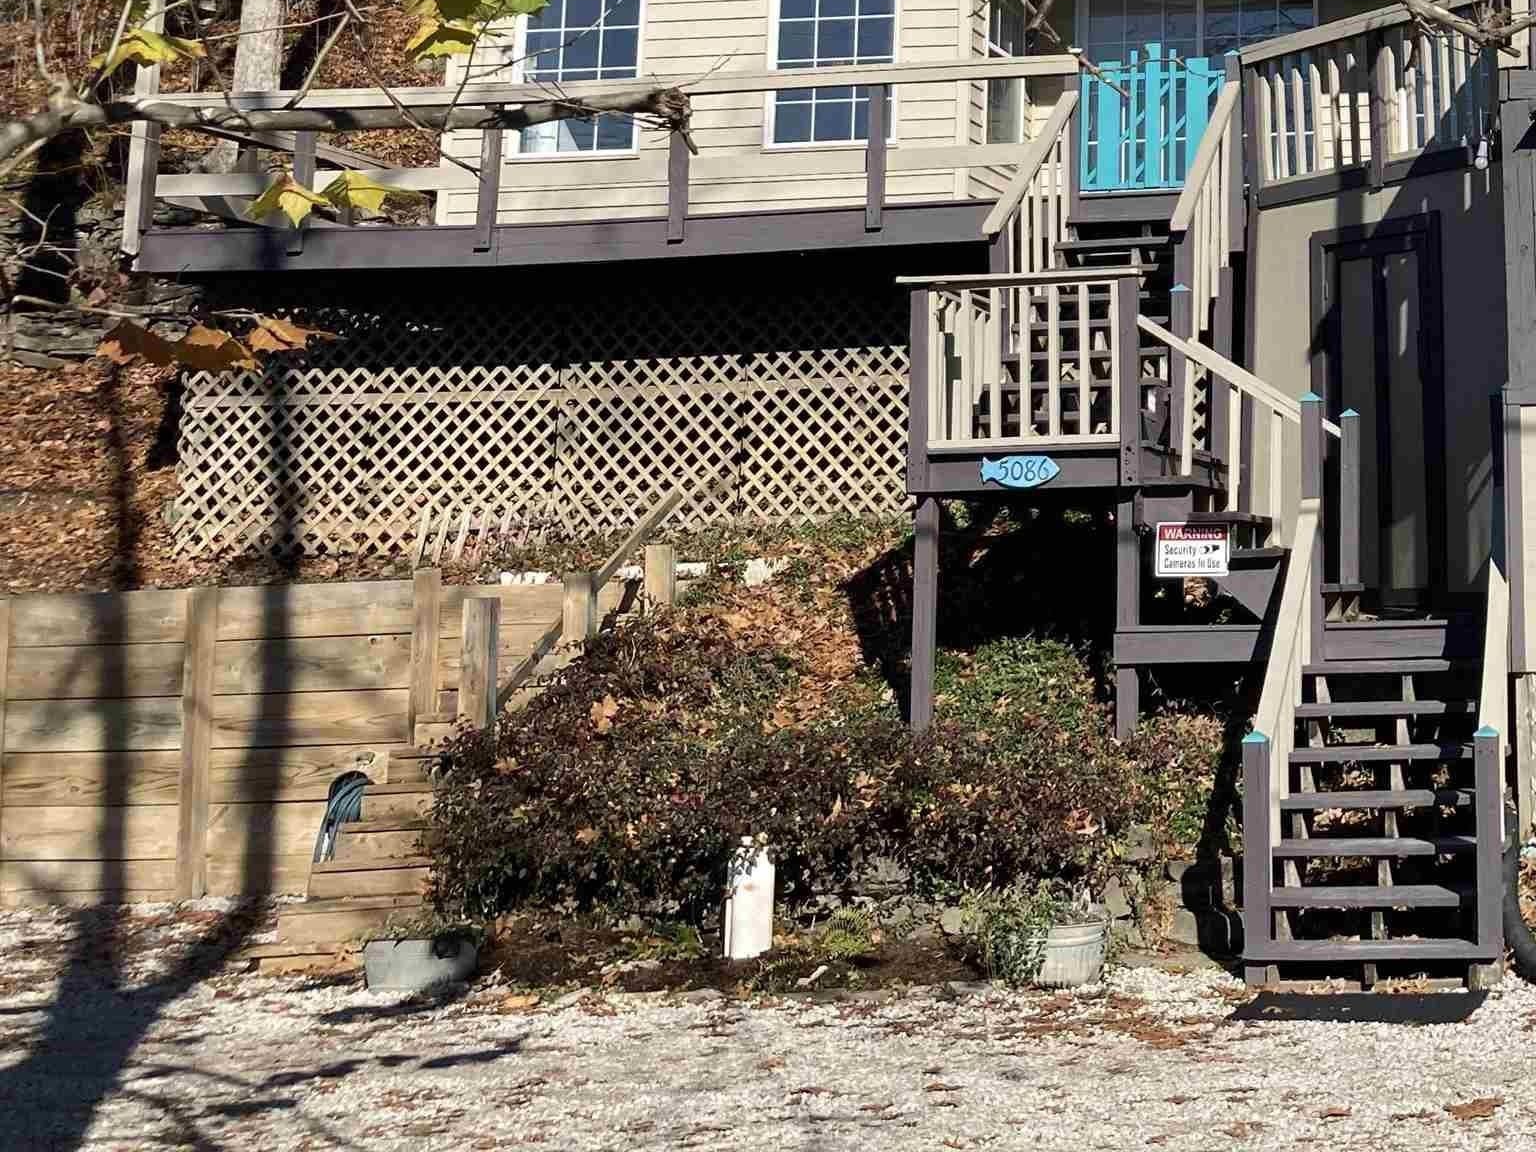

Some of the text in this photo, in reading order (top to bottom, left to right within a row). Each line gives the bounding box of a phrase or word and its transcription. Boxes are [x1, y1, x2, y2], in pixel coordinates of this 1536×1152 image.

[999, 459, 1050, 481] 5086
[1164, 528, 1223, 539] WARNING
[1164, 544, 1197, 556] Security
[1164, 558, 1196, 569] Cameras
[1207, 558, 1221, 568] Use
